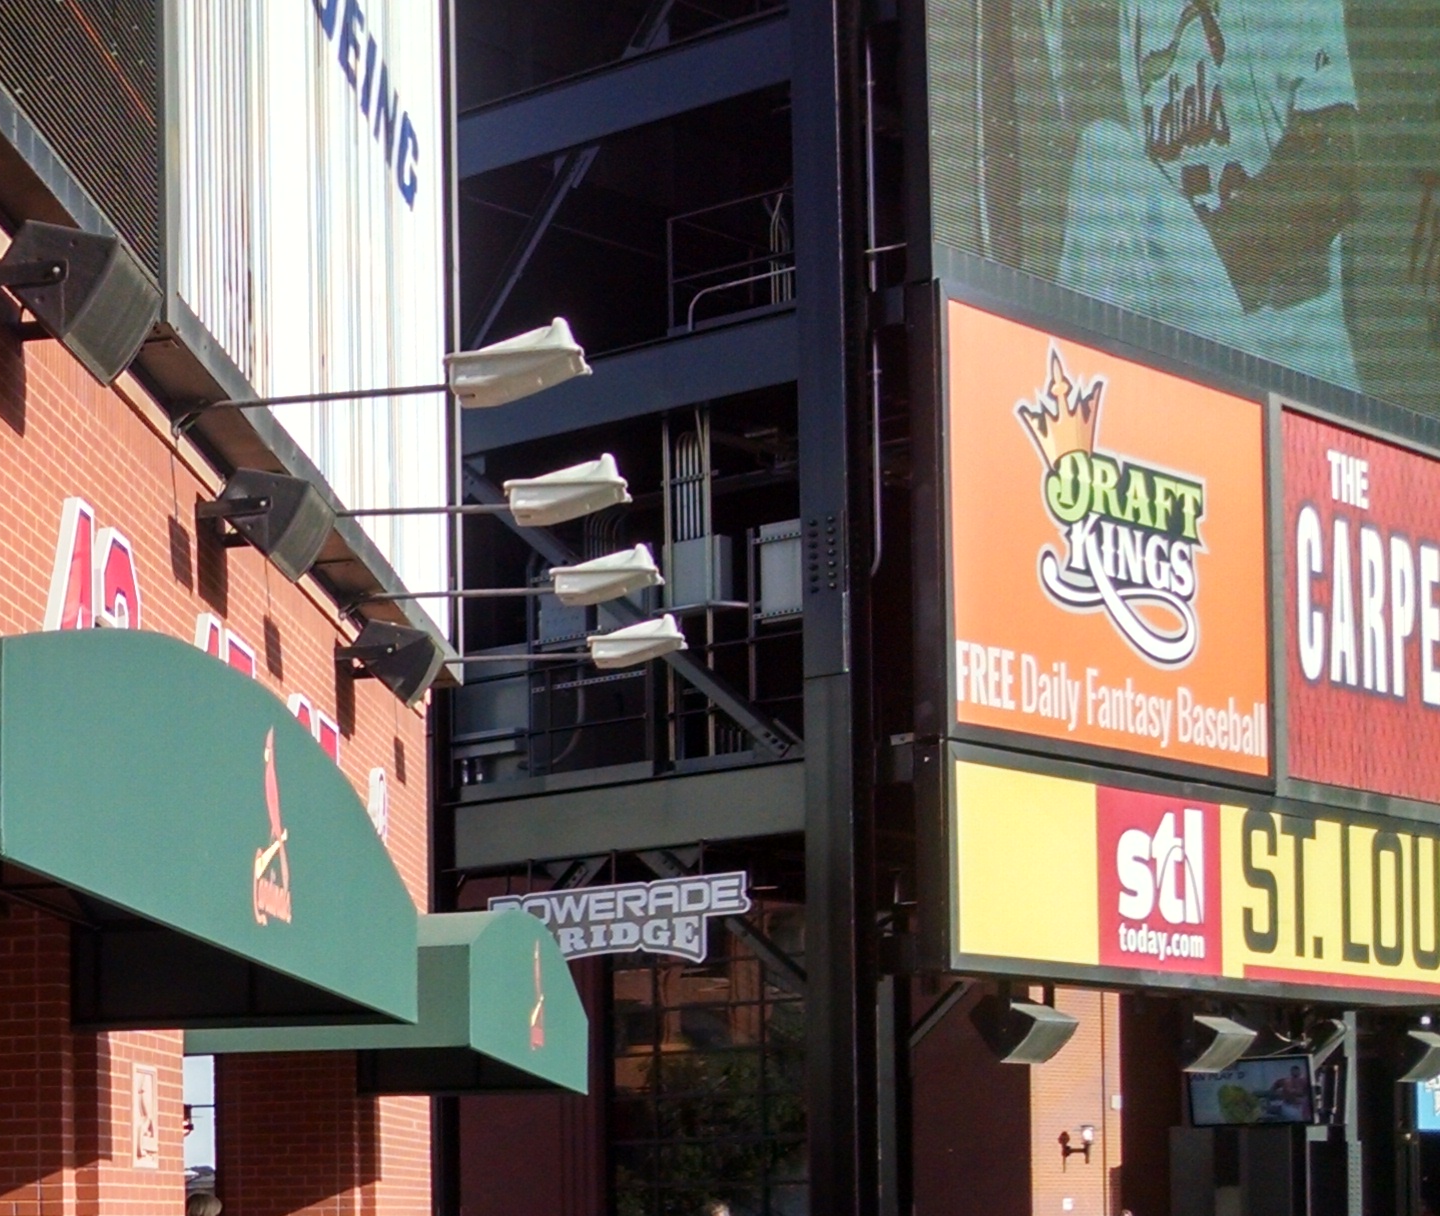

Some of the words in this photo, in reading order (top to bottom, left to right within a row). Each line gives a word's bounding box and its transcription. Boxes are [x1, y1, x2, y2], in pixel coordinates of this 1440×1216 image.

[1046, 450, 1202, 540] DRAFT
[1328, 449, 1368, 510] THE
[1297, 505, 1440, 706] CARPE
[956, 640, 1015, 710] FREE
[1021, 653, 1080, 731] Daily
[1086, 667, 1172, 748] Fantasy
[1177, 687, 1267, 757] Baseball
[1116, 808, 1204, 924] stl
[1241, 808, 1323, 960] ST.
[1341, 822, 1440, 971] LOU
[553, 916, 701, 953] RIDGE
[1118, 922, 1205, 960] today.com
